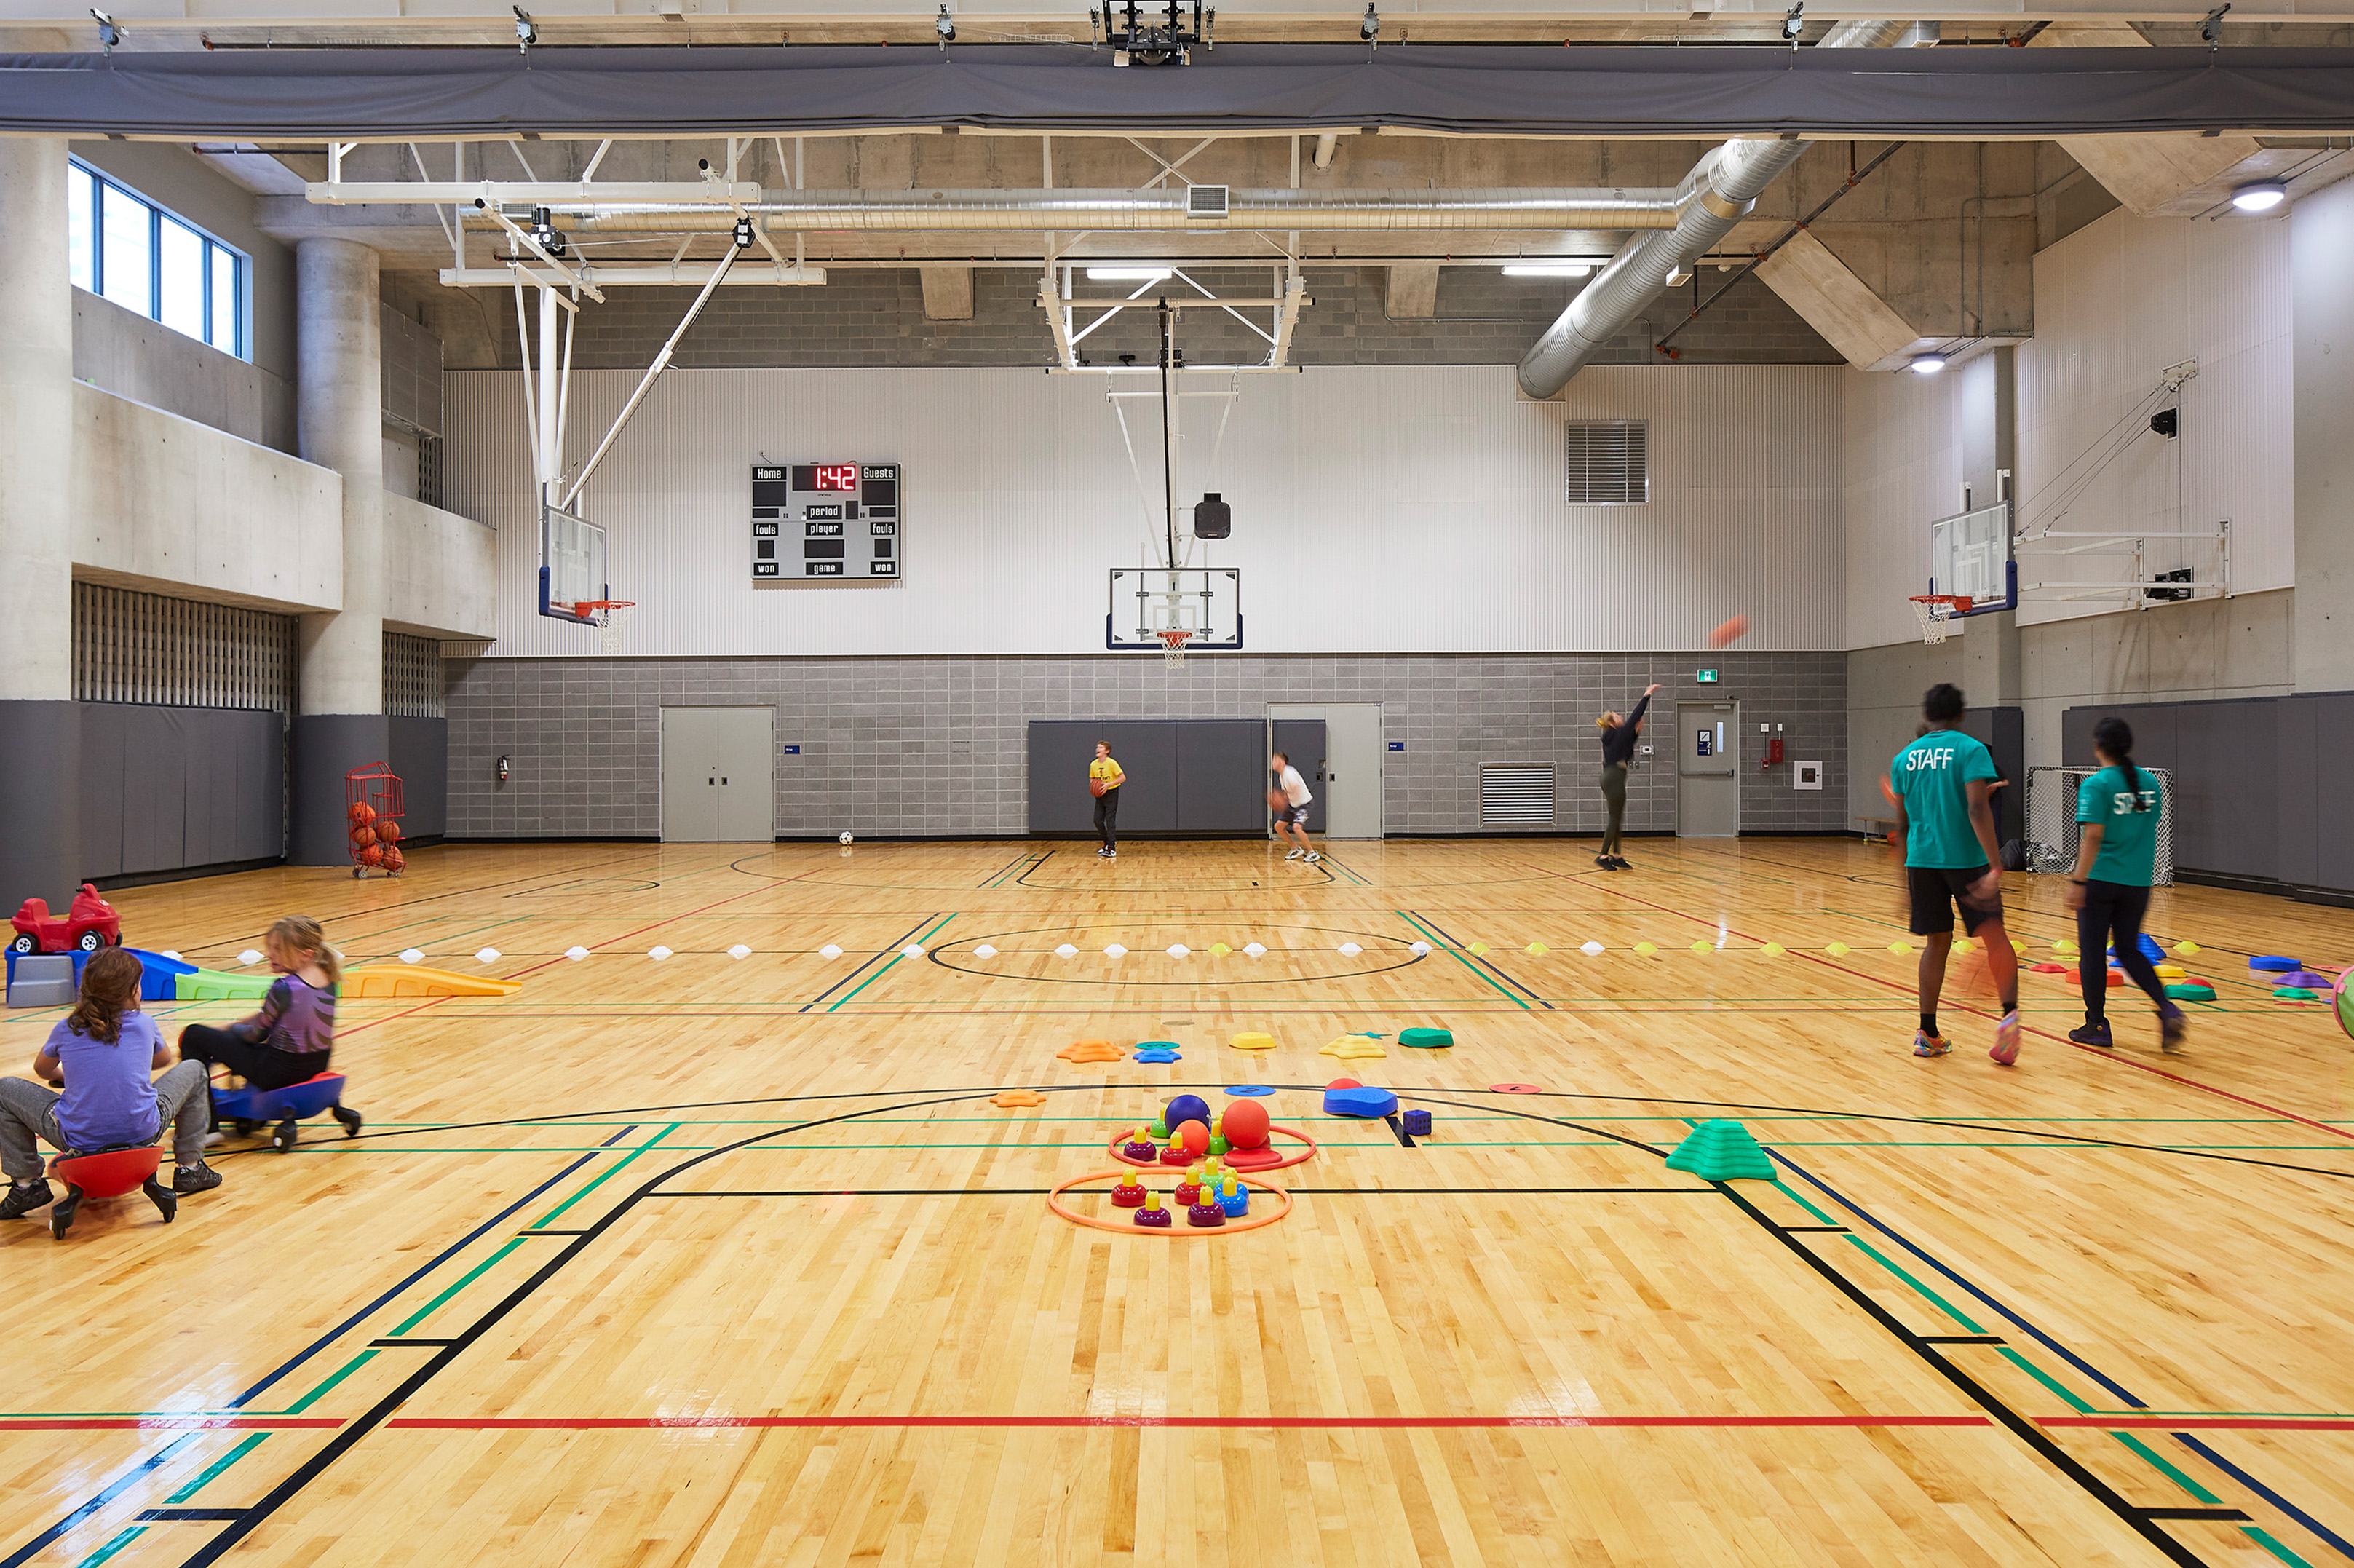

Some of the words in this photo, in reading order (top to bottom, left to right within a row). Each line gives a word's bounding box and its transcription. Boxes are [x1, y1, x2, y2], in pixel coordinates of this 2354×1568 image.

[757, 468, 782, 479] Home
[817, 466, 855, 489] 1:42
[863, 467, 894, 478] Guests
[810, 506, 838, 518] period
[756, 525, 776, 534] fouls
[810, 523, 839, 535] player
[873, 523, 893, 534] fouls
[758, 565, 774, 573] won
[814, 564, 836, 574] game
[875, 563, 892, 571] won
[1906, 748, 1954, 772] STAFF
